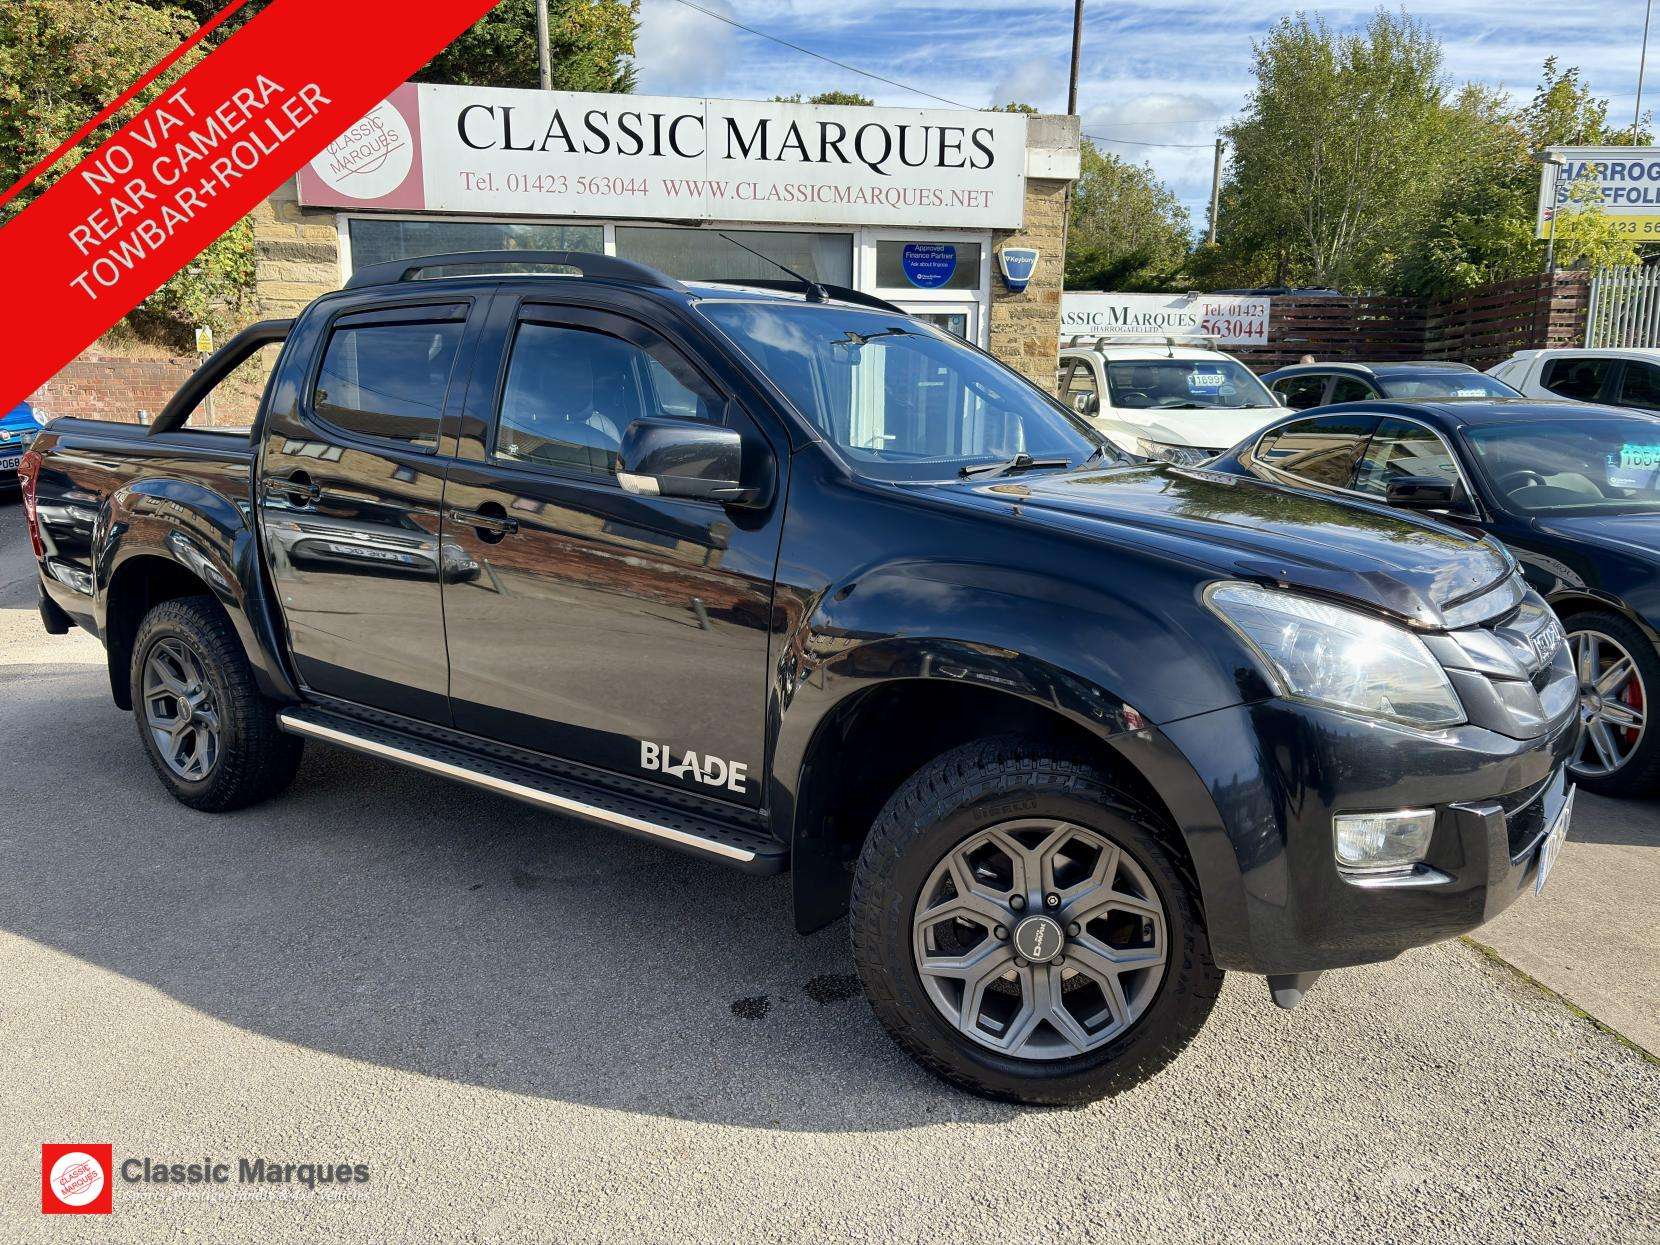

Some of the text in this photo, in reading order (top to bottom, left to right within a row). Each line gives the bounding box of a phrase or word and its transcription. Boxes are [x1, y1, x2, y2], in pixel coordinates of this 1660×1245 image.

[327, 116, 384, 155] CLASSIC
[329, 130, 399, 174] MARQUES
[457, 104, 995, 176] CLASSIC MARQUES
[460, 171, 994, 209] Tel. 01423 563044 WWW.CLASSICMARQUES.NET
[914, 243, 945, 252] Approved
[1108, 306, 1196, 329] MARQUES
[1200, 319, 1264, 339] 563044
[1202, 304, 1264, 317] Tel. 01423
[640, 740, 748, 794] BLADE
